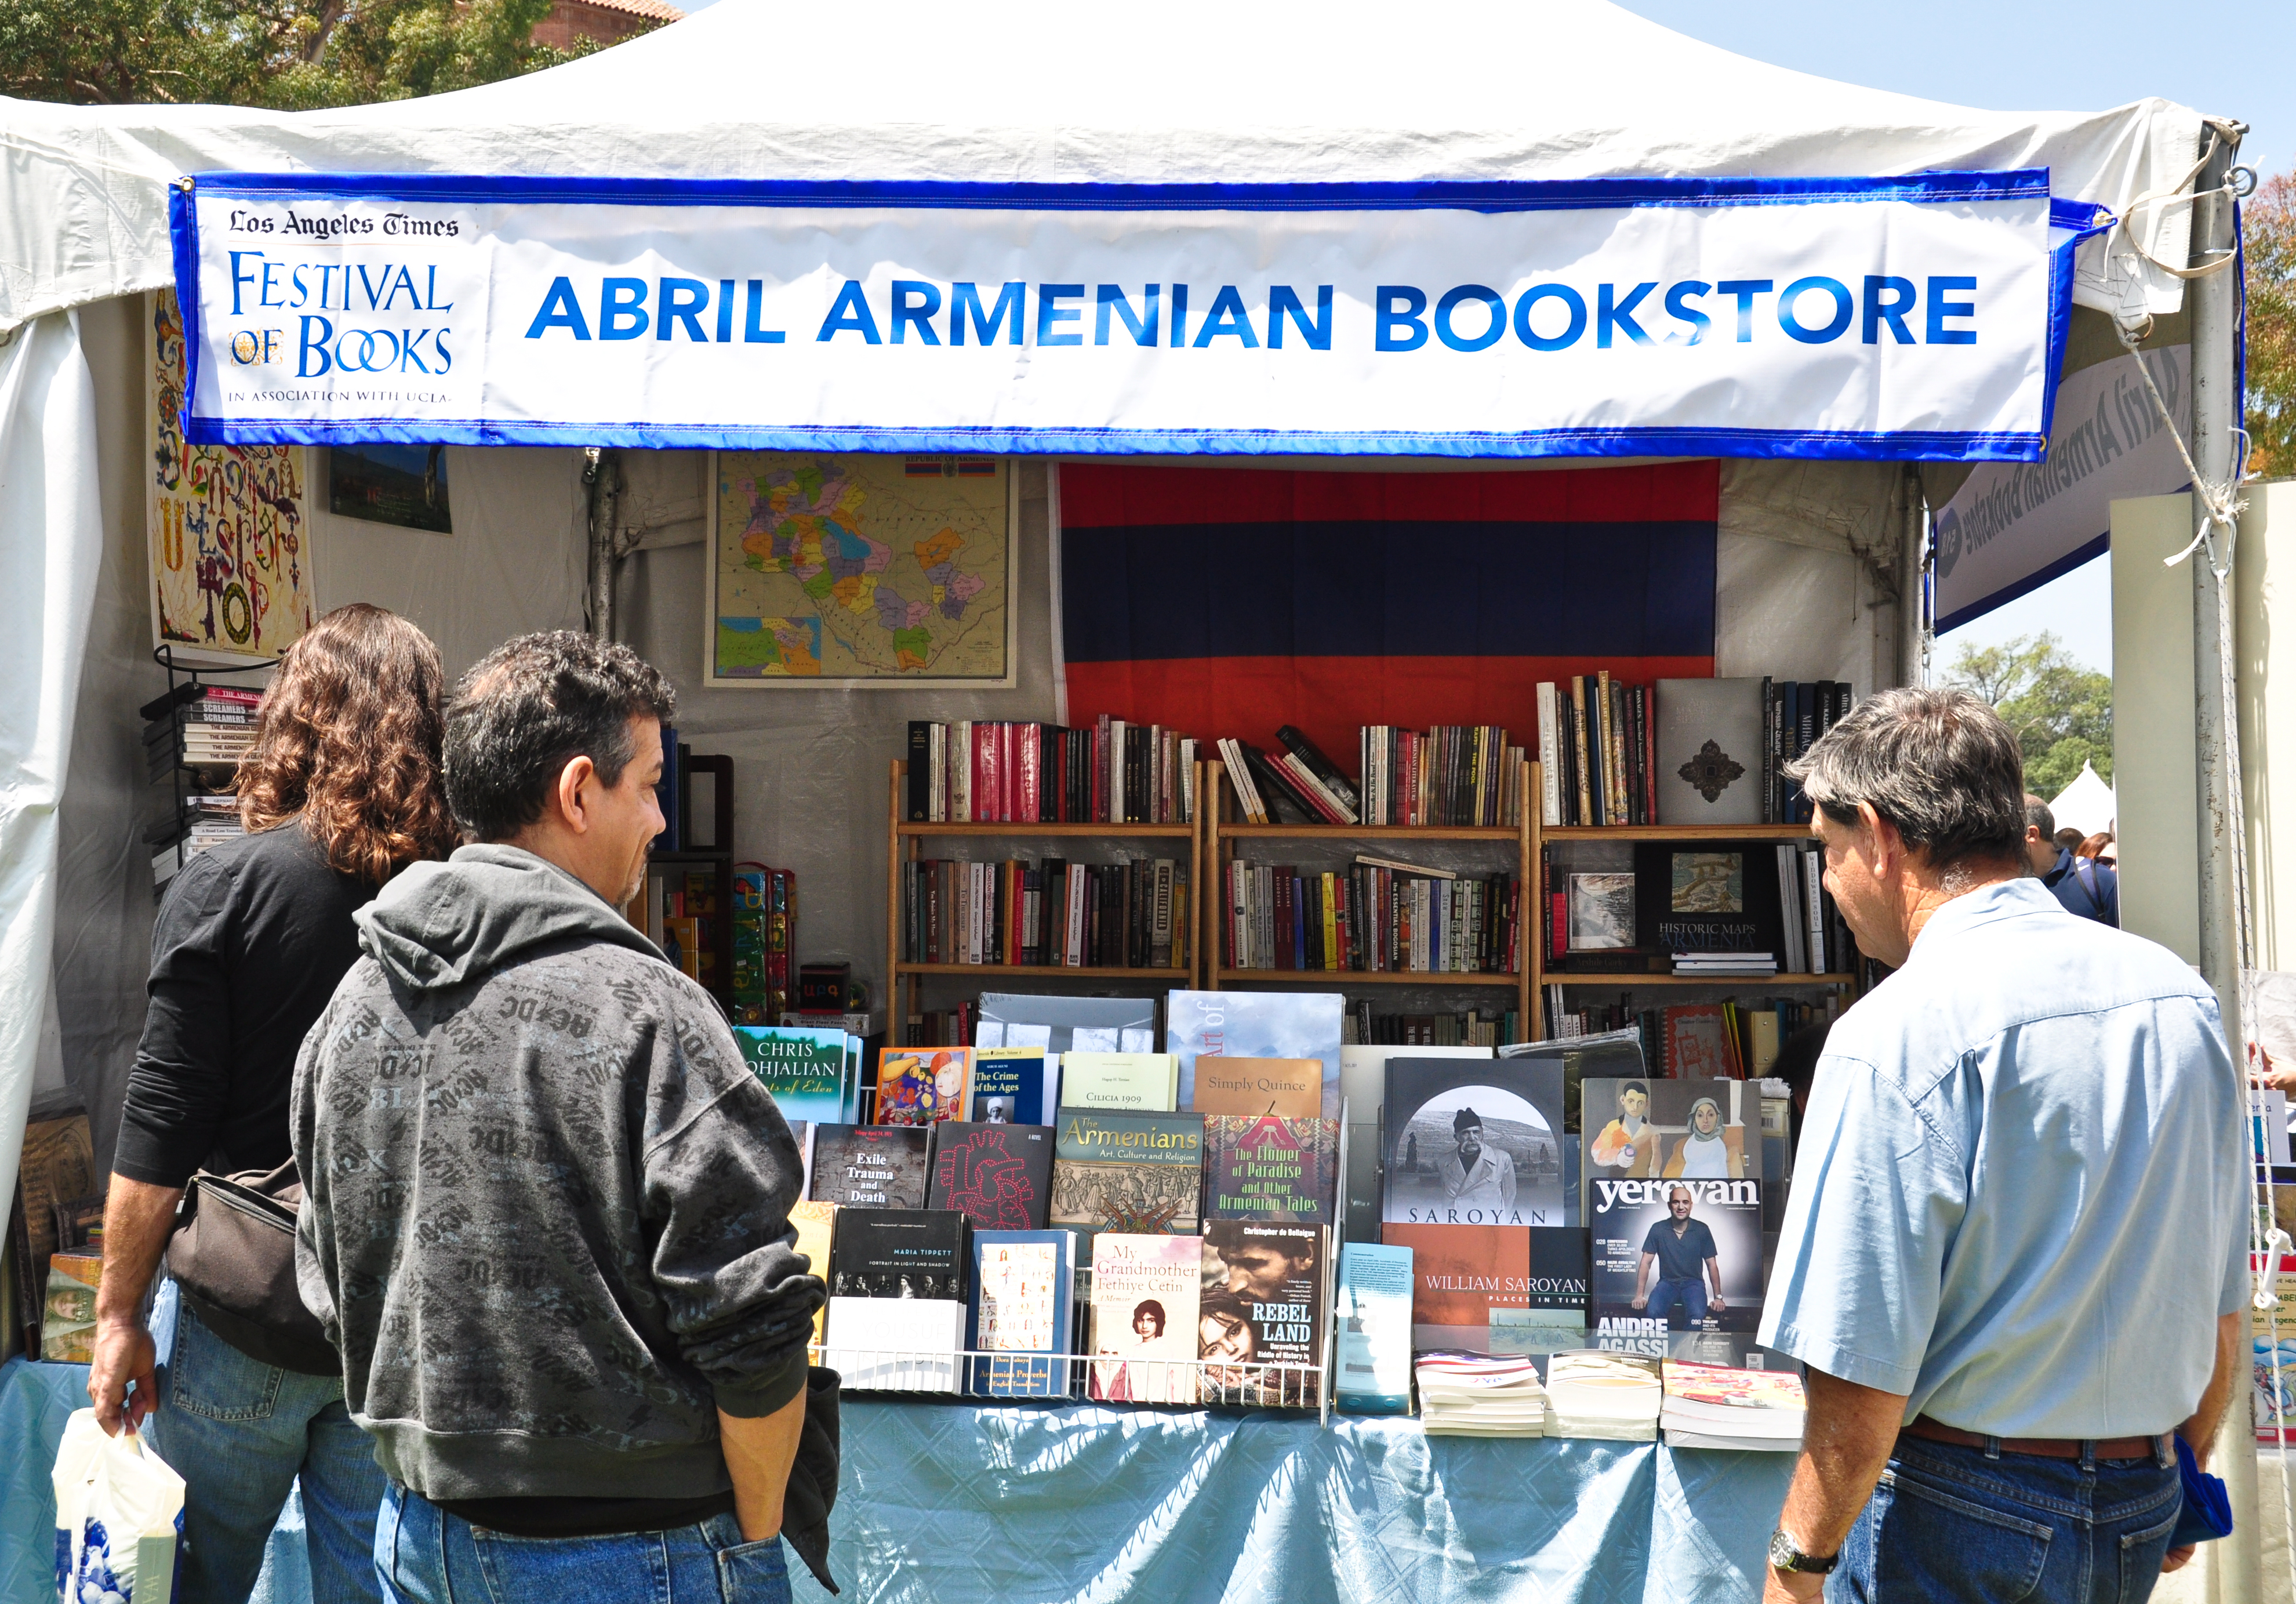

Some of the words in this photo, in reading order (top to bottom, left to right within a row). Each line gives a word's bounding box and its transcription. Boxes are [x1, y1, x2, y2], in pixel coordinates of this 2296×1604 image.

[229, 210, 274, 233] Los
[281, 209, 374, 240] Angeles
[383, 213, 459, 237] Times
[228, 251, 454, 315] FESTIVAL
[524, 276, 786, 344] ABRIL
[815, 280, 1332, 351] ARMENIAN
[1375, 275, 1978, 352] BOOKSTORE
[232, 329, 282, 365] OF
[296, 315, 451, 378] BOOKS
[228, 393, 245, 402] IN
[252, 391, 350, 402] ASSOCIATION
[356, 392, 399, 402] WITH
[203, 704, 246, 714] SCREAMERS
[203, 714, 246, 723] SCREAMERS
[1801, 714, 1812, 750] МИНАС
[1808, 855, 1818, 895] WINDOWS
[961, 888, 968, 898] To
[1146, 888, 1153, 896] MY
[1158, 883, 1168, 928] CALIFORNIA
[1659, 923, 1719, 935] HISTORIC
[1721, 924, 1756, 935] MAPS
[1660, 932, 1754, 948] ARMENIA
[1197, 1000, 1225, 1026] of
[1407, 1026, 1416, 1035] THE
[1422, 1026, 1431, 1035] THE
[757, 1042, 812, 1057] CHRIS
[746, 1061, 835, 1079] OHJALIAN
[976, 1072, 991, 1081] The
[993, 1072, 1019, 1081] Crime
[784, 1079, 800, 1095] of
[802, 1079, 833, 1093] Eden
[974, 1082, 983, 1092] of
[983, 1083, 997, 1092] the
[998, 1083, 1019, 1094] Ages
[1209, 1077, 1254, 1093] Simply
[1257, 1077, 1306, 1092] Quince
[1086, 1092, 1118, 1102] CILICIA
[1122, 1095, 1142, 1104] 1909
[1082, 1117, 1098, 1129] The
[1062, 1117, 1198, 1150] Armenians
[856, 1152, 887, 1165] Exile
[1117, 1149, 1146, 1159] Culture
[1149, 1151, 1162, 1160] and
[1165, 1151, 1195, 1163] Religion
[1234, 1148, 1252, 1162] The
[1256, 1145, 1301, 1163] Flower
[847, 1166, 894, 1181] Trauma
[1232, 1163, 1244, 1177] of
[1247, 1161, 1302, 1178] Paradise
[860, 1181, 878, 1190] and
[1241, 1181, 1260, 1195] and
[1264, 1181, 1292, 1196] Other
[850, 1190, 886, 1203] Death
[1219, 1194, 1281, 1212] Armenian
[1285, 1195, 1318, 1213] Tales
[1408, 1207, 1547, 1225] SAROYAN
[1243, 1226, 1277, 1236] Christopher
[1278, 1228, 1287, 1236] de
[1287, 1228, 1316, 1238] Bellaigue
[1113, 1244, 1138, 1264] My
[1096, 1260, 1197, 1277] Grandmother
[1096, 1278, 1145, 1294] Fethiye
[1426, 1275, 1501, 1291] WILLIAM
[1505, 1276, 1586, 1294] SAROYAN
[1488, 1295, 1530, 1303] PLACES
[1252, 1302, 1311, 1323] REBEL
[1262, 1323, 1311, 1342] LAND
[1597, 1317, 1668, 1338] ANDRE
[1270, 1342, 1299, 1352] Unraveling
[1300, 1344, 1310, 1352] the
[1597, 1338, 1669, 1358] AGASSI
[1257, 1351, 1275, 1359] Riddle
[1283, 1352, 1303, 1361] History
